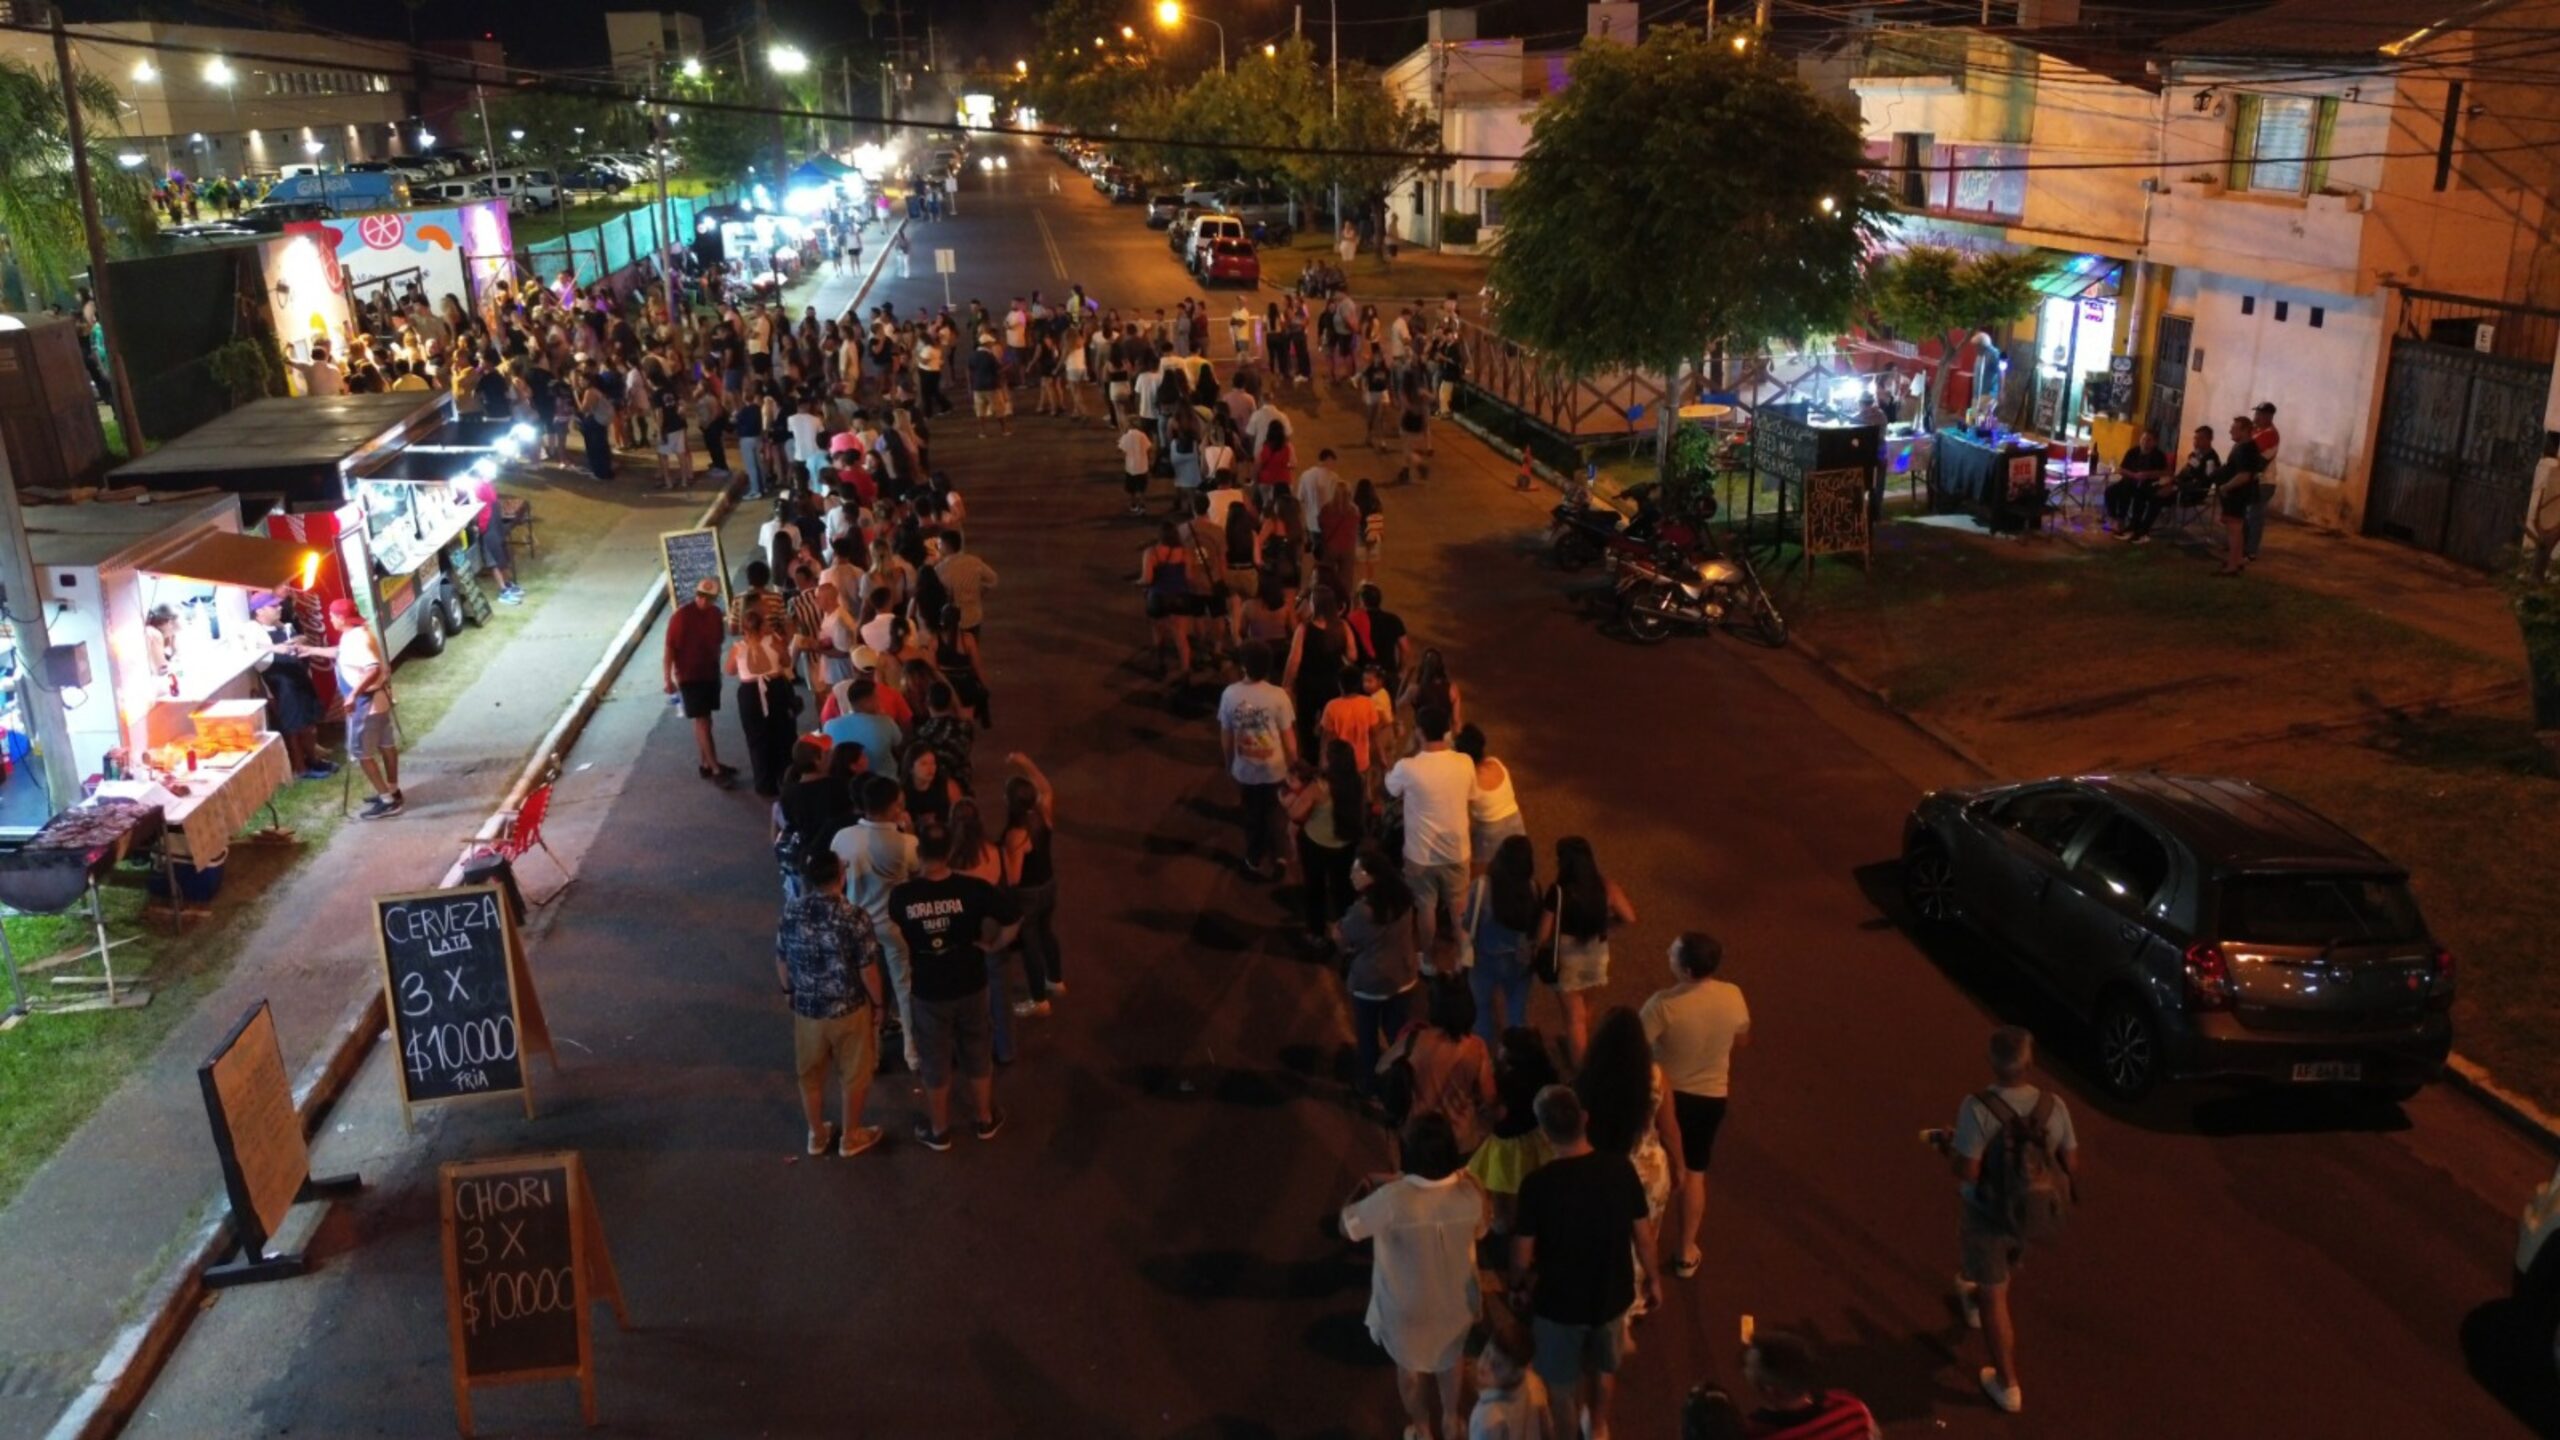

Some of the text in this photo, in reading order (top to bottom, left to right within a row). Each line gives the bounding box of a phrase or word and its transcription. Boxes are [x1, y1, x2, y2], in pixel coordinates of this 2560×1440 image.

[385, 895, 500, 943] CERVEZA
[905, 899, 963, 920] BORA BORA
[427, 932, 472, 957] LATA
[401, 971, 433, 1016] 3
[406, 1014, 517, 1082] $10.000
[456, 1176, 551, 1222] CHORI
[463, 1226, 489, 1264] 3
[463, 1266, 576, 1336] $10.000
